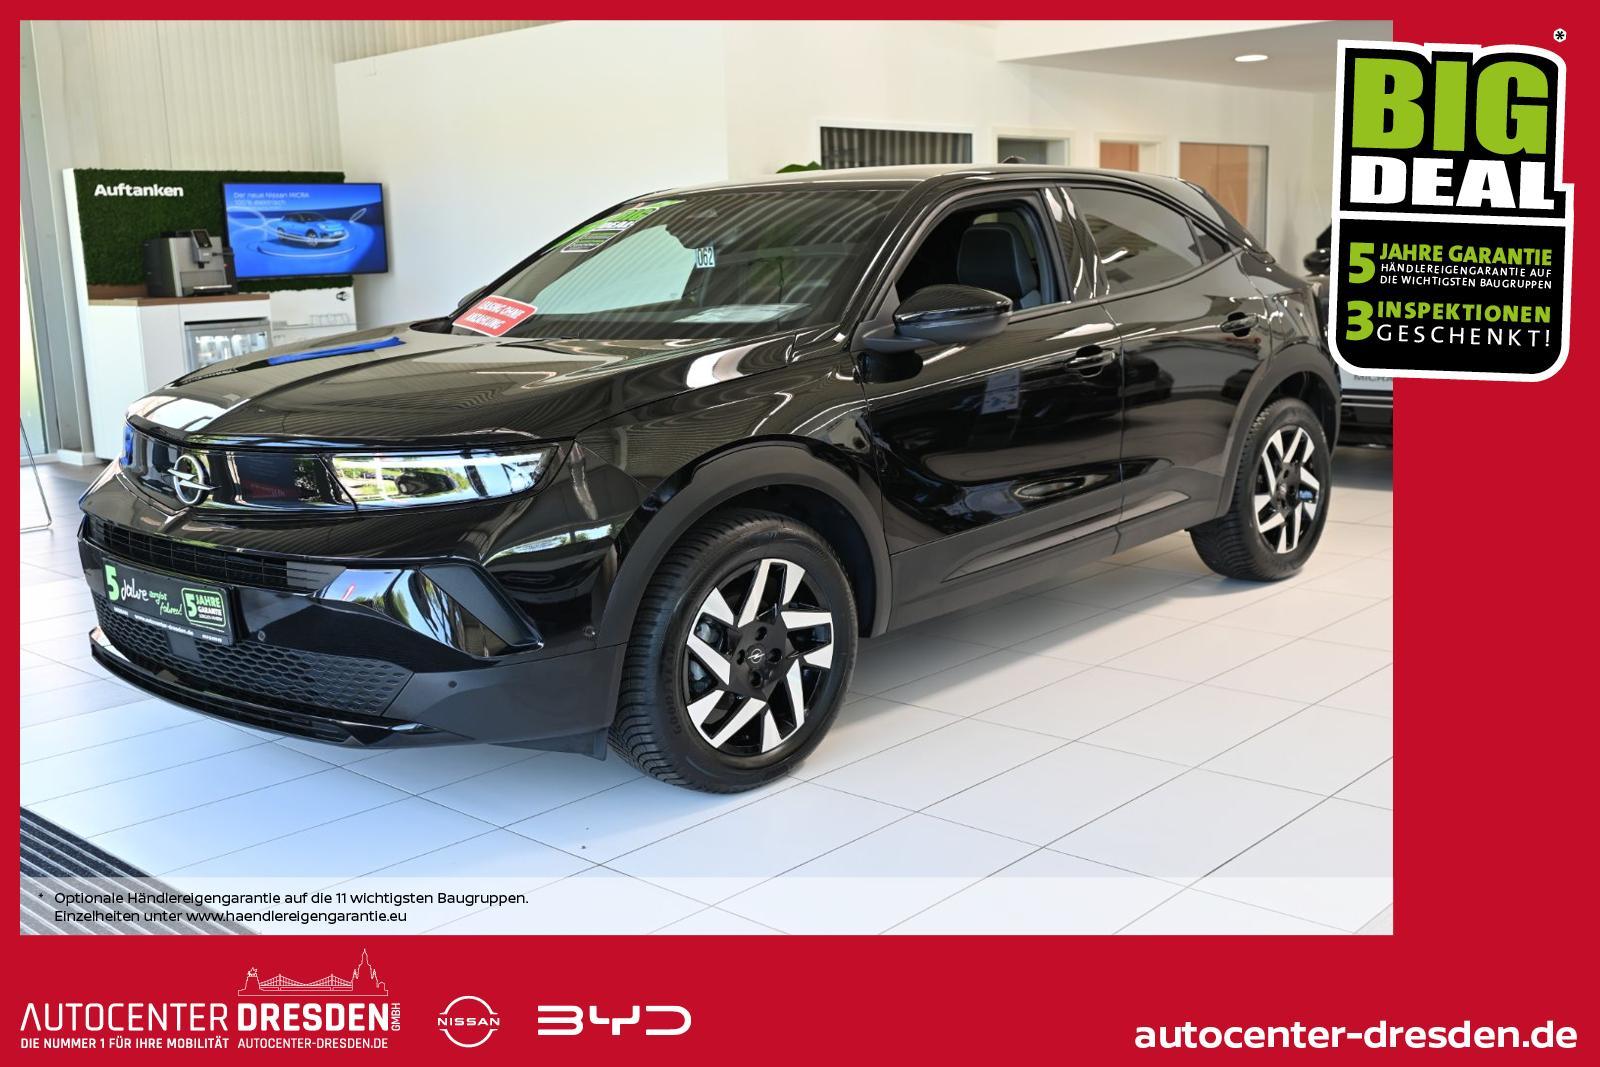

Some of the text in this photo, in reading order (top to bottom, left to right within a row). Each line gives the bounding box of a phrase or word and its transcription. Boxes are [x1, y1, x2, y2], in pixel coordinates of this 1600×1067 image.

[94, 183, 184, 197] Auftanken
[697, 247, 713, 266] 062
[104, 563, 120, 601] 5
[185, 593, 221, 617] 5 JAHRE
